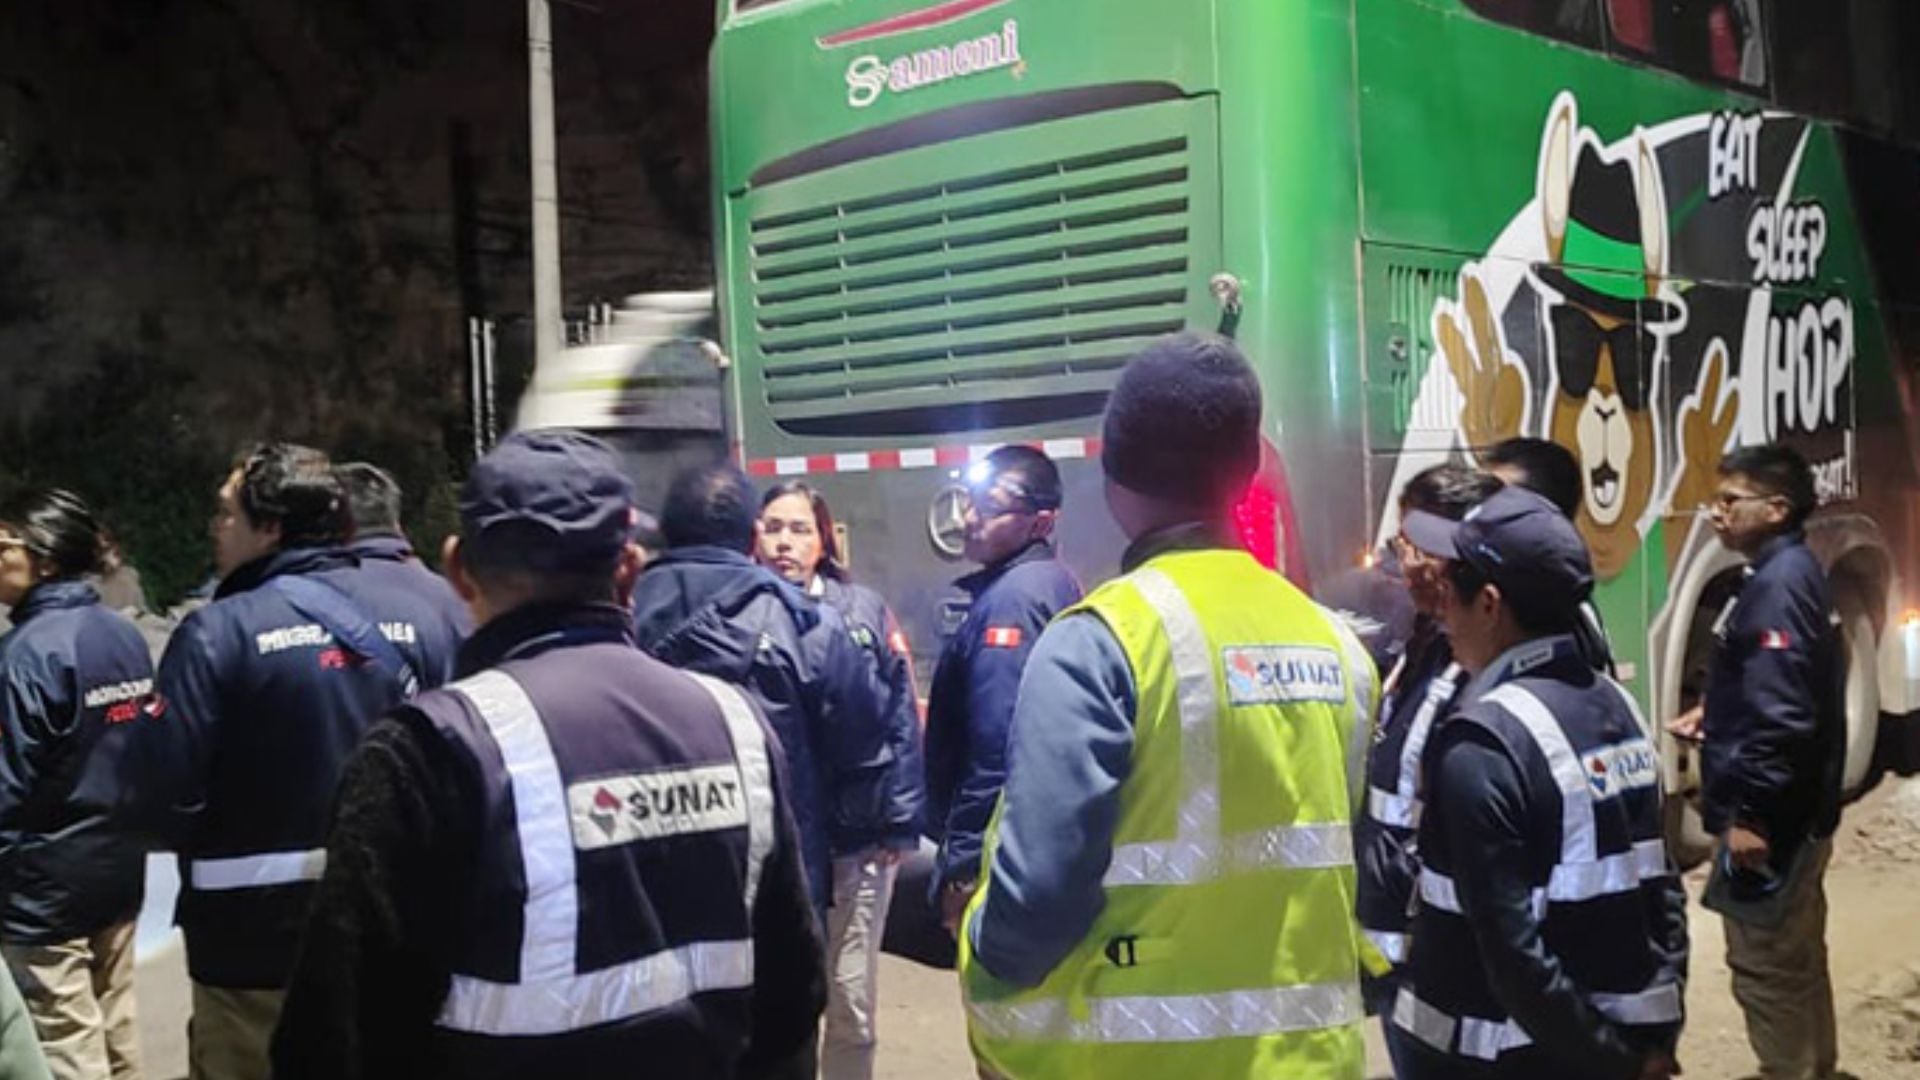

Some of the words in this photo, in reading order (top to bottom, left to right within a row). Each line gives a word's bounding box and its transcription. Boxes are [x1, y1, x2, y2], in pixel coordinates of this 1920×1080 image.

[1708, 113, 1763, 197] EAT
[1746, 204, 1826, 281] SLEEP
[1768, 296, 1850, 442] HOP
[1256, 660, 1340, 686] SUNAT
[627, 781, 736, 820] SUNAT
